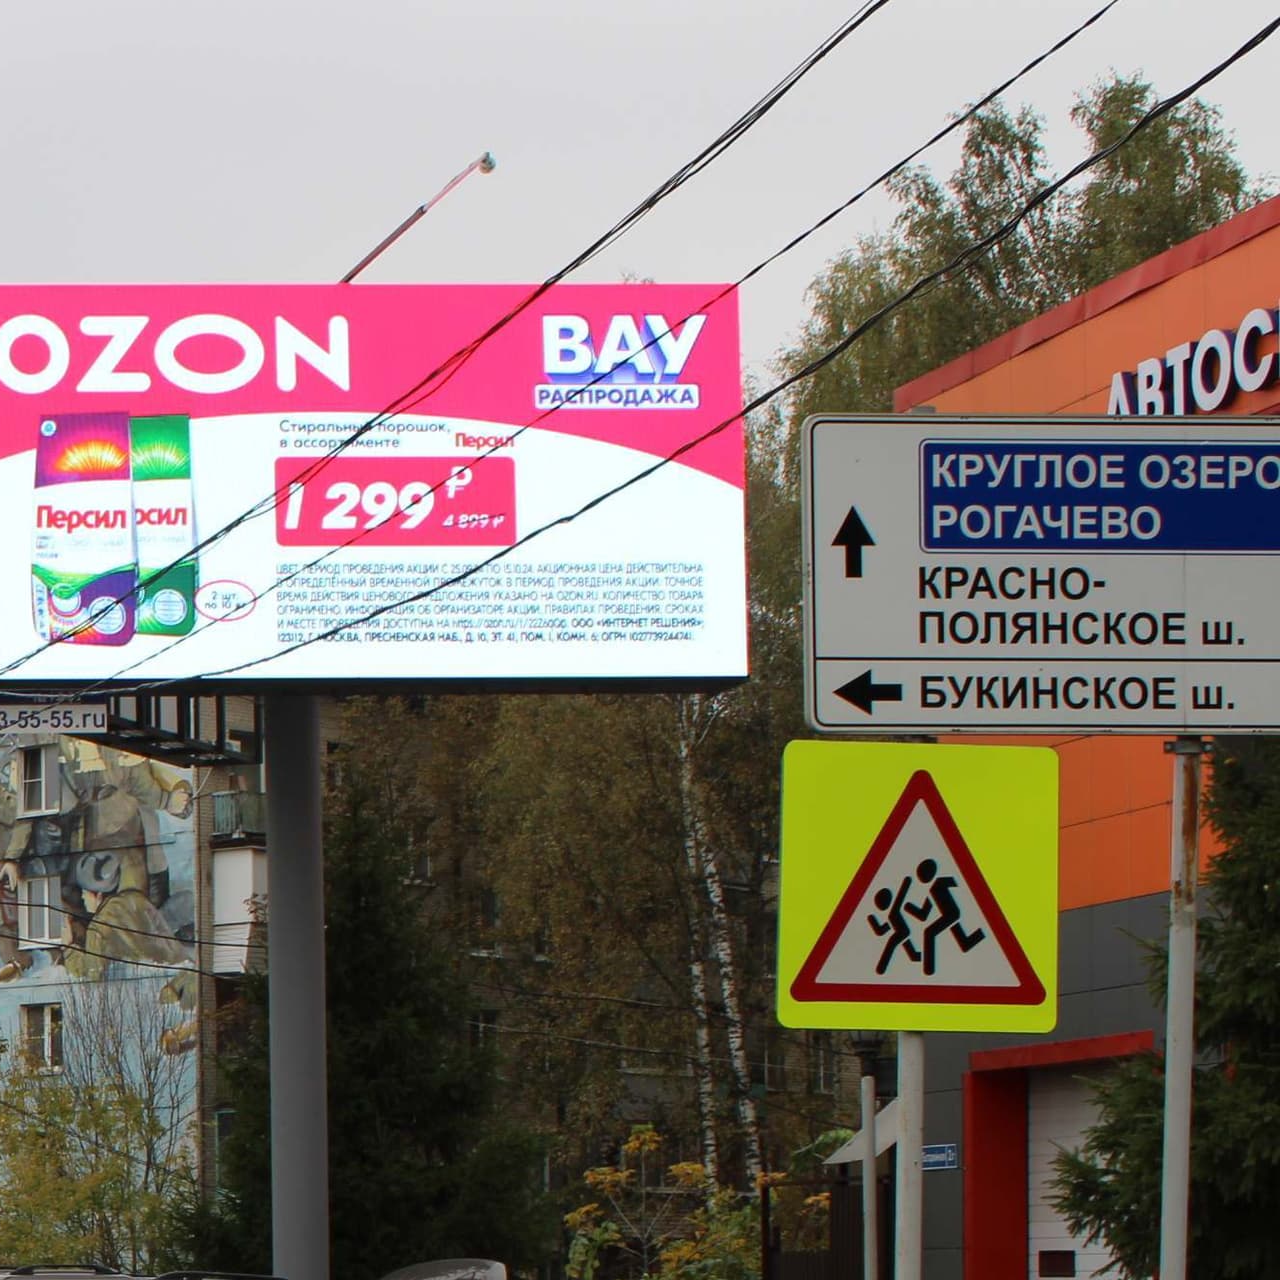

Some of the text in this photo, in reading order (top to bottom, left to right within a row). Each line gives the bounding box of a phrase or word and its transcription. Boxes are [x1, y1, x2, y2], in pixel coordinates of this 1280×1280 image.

[542, 314, 708, 376] ВАУ
[1107, 300, 1280, 416] АВТОС
[539, 388, 694, 406] РАСПРОДАЖА
[279, 419, 451, 436] Стиральны порошок,
[279, 439, 288, 448] в
[455, 433, 515, 450] Персил
[931, 454, 1280, 489] КРУГЛОЕ ОЗЕРО
[284, 481, 305, 529] 1
[321, 481, 435, 529] 299
[36, 505, 127, 533] Персил
[931, 505, 1161, 540] РОГАЧЕВО
[342, 563, 405, 574] ПРОВЕДЕНИЯ
[407, 563, 438, 574] АКЦИИ
[537, 563, 596, 574] АКЦИОННАЯ
[599, 563, 622, 574] ЦЕНА
[626, 563, 703, 574] ДЕЙСТВИТЕЛЬНА
[369, 577, 430, 588] ВРЕМЕННОЙ
[506, 577, 512, 588] В
[515, 577, 554, 588] ПЕРИОД
[558, 577, 621, 588] ПРОВЕДЕНИЯ
[664, 577, 703, 588] ТОЧНОЕ
[918, 566, 1106, 600] КРАСНО-
[277, 591, 307, 602] ВРЕМЯ
[310, 591, 359, 602] ДЕЙСТВИЯ
[494, 591, 537, 602] УКАЗАНО
[541, 591, 554, 602] НА
[602, 591, 665, 602] КОЛИЧЕСТВО
[669, 591, 703, 602] ТОВАРА
[417, 605, 431, 615] ОБ
[434, 605, 503, 615] ОРГАНИЗАТОРЕ
[545, 605, 594, 615] ПРАВИЛАХ
[665, 605, 703, 615] СРОКАХ
[277, 619, 283, 629] И
[287, 619, 316, 629] МЕСТЕ
[383, 619, 433, 629] ДОСТУПНА
[437, 619, 449, 629] НА
[571, 619, 593, 629] ООО
[596, 619, 648, 629] «ИНТЕРНЕТ
[918, 611, 1245, 645] ПОЛЯНСКОЕ ш.
[365, 632, 435, 643] ПРЕСНЕНСКАЯ
[520, 632, 544, 643] ПОМ.
[602, 632, 626, 643] ОГРН
[920, 676, 1235, 709] БУКИНСКОЕ ш.
